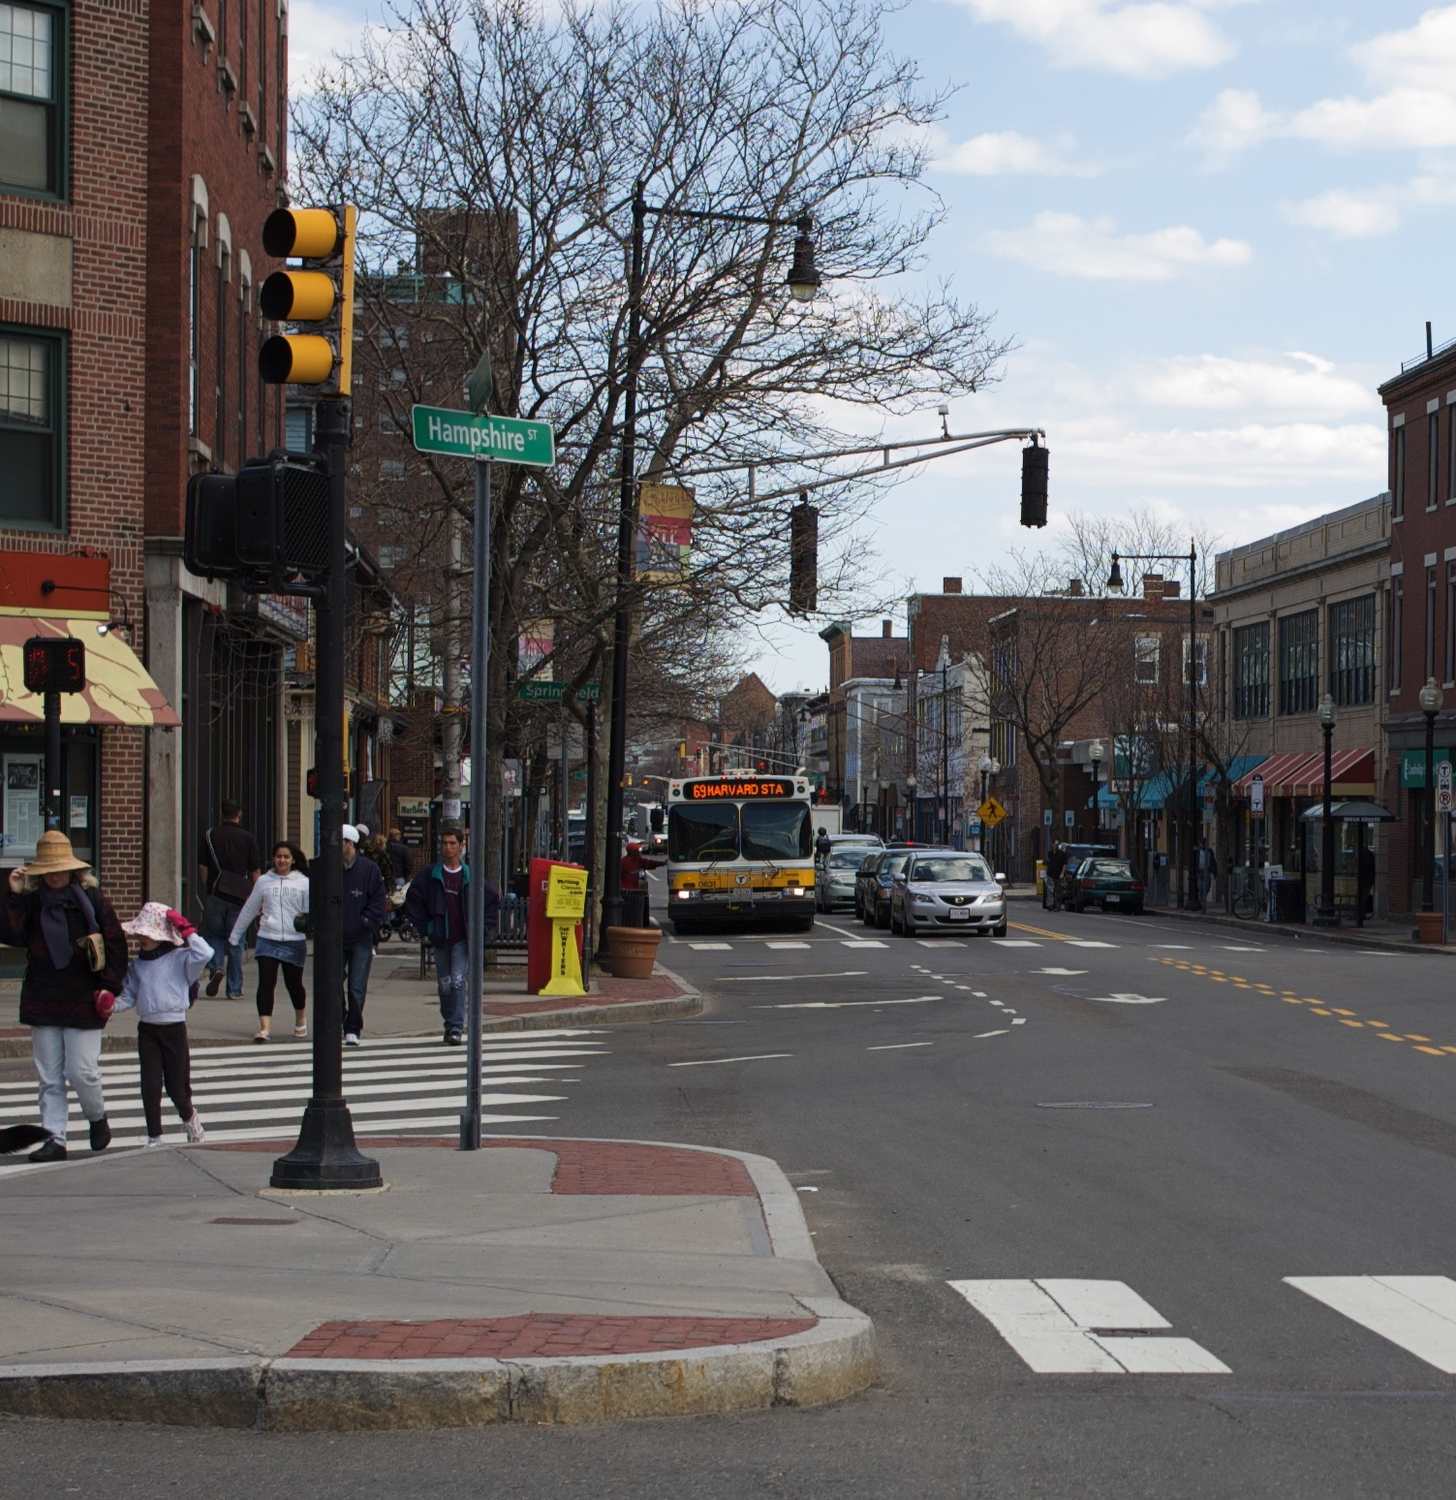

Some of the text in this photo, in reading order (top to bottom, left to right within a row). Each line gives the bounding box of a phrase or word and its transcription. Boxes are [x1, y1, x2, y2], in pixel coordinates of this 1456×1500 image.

[428, 415, 537, 452] Hampshire ST
[526, 685, 599, 698] Sprineld
[693, 784, 783, 798] 69 HARVARD STA
